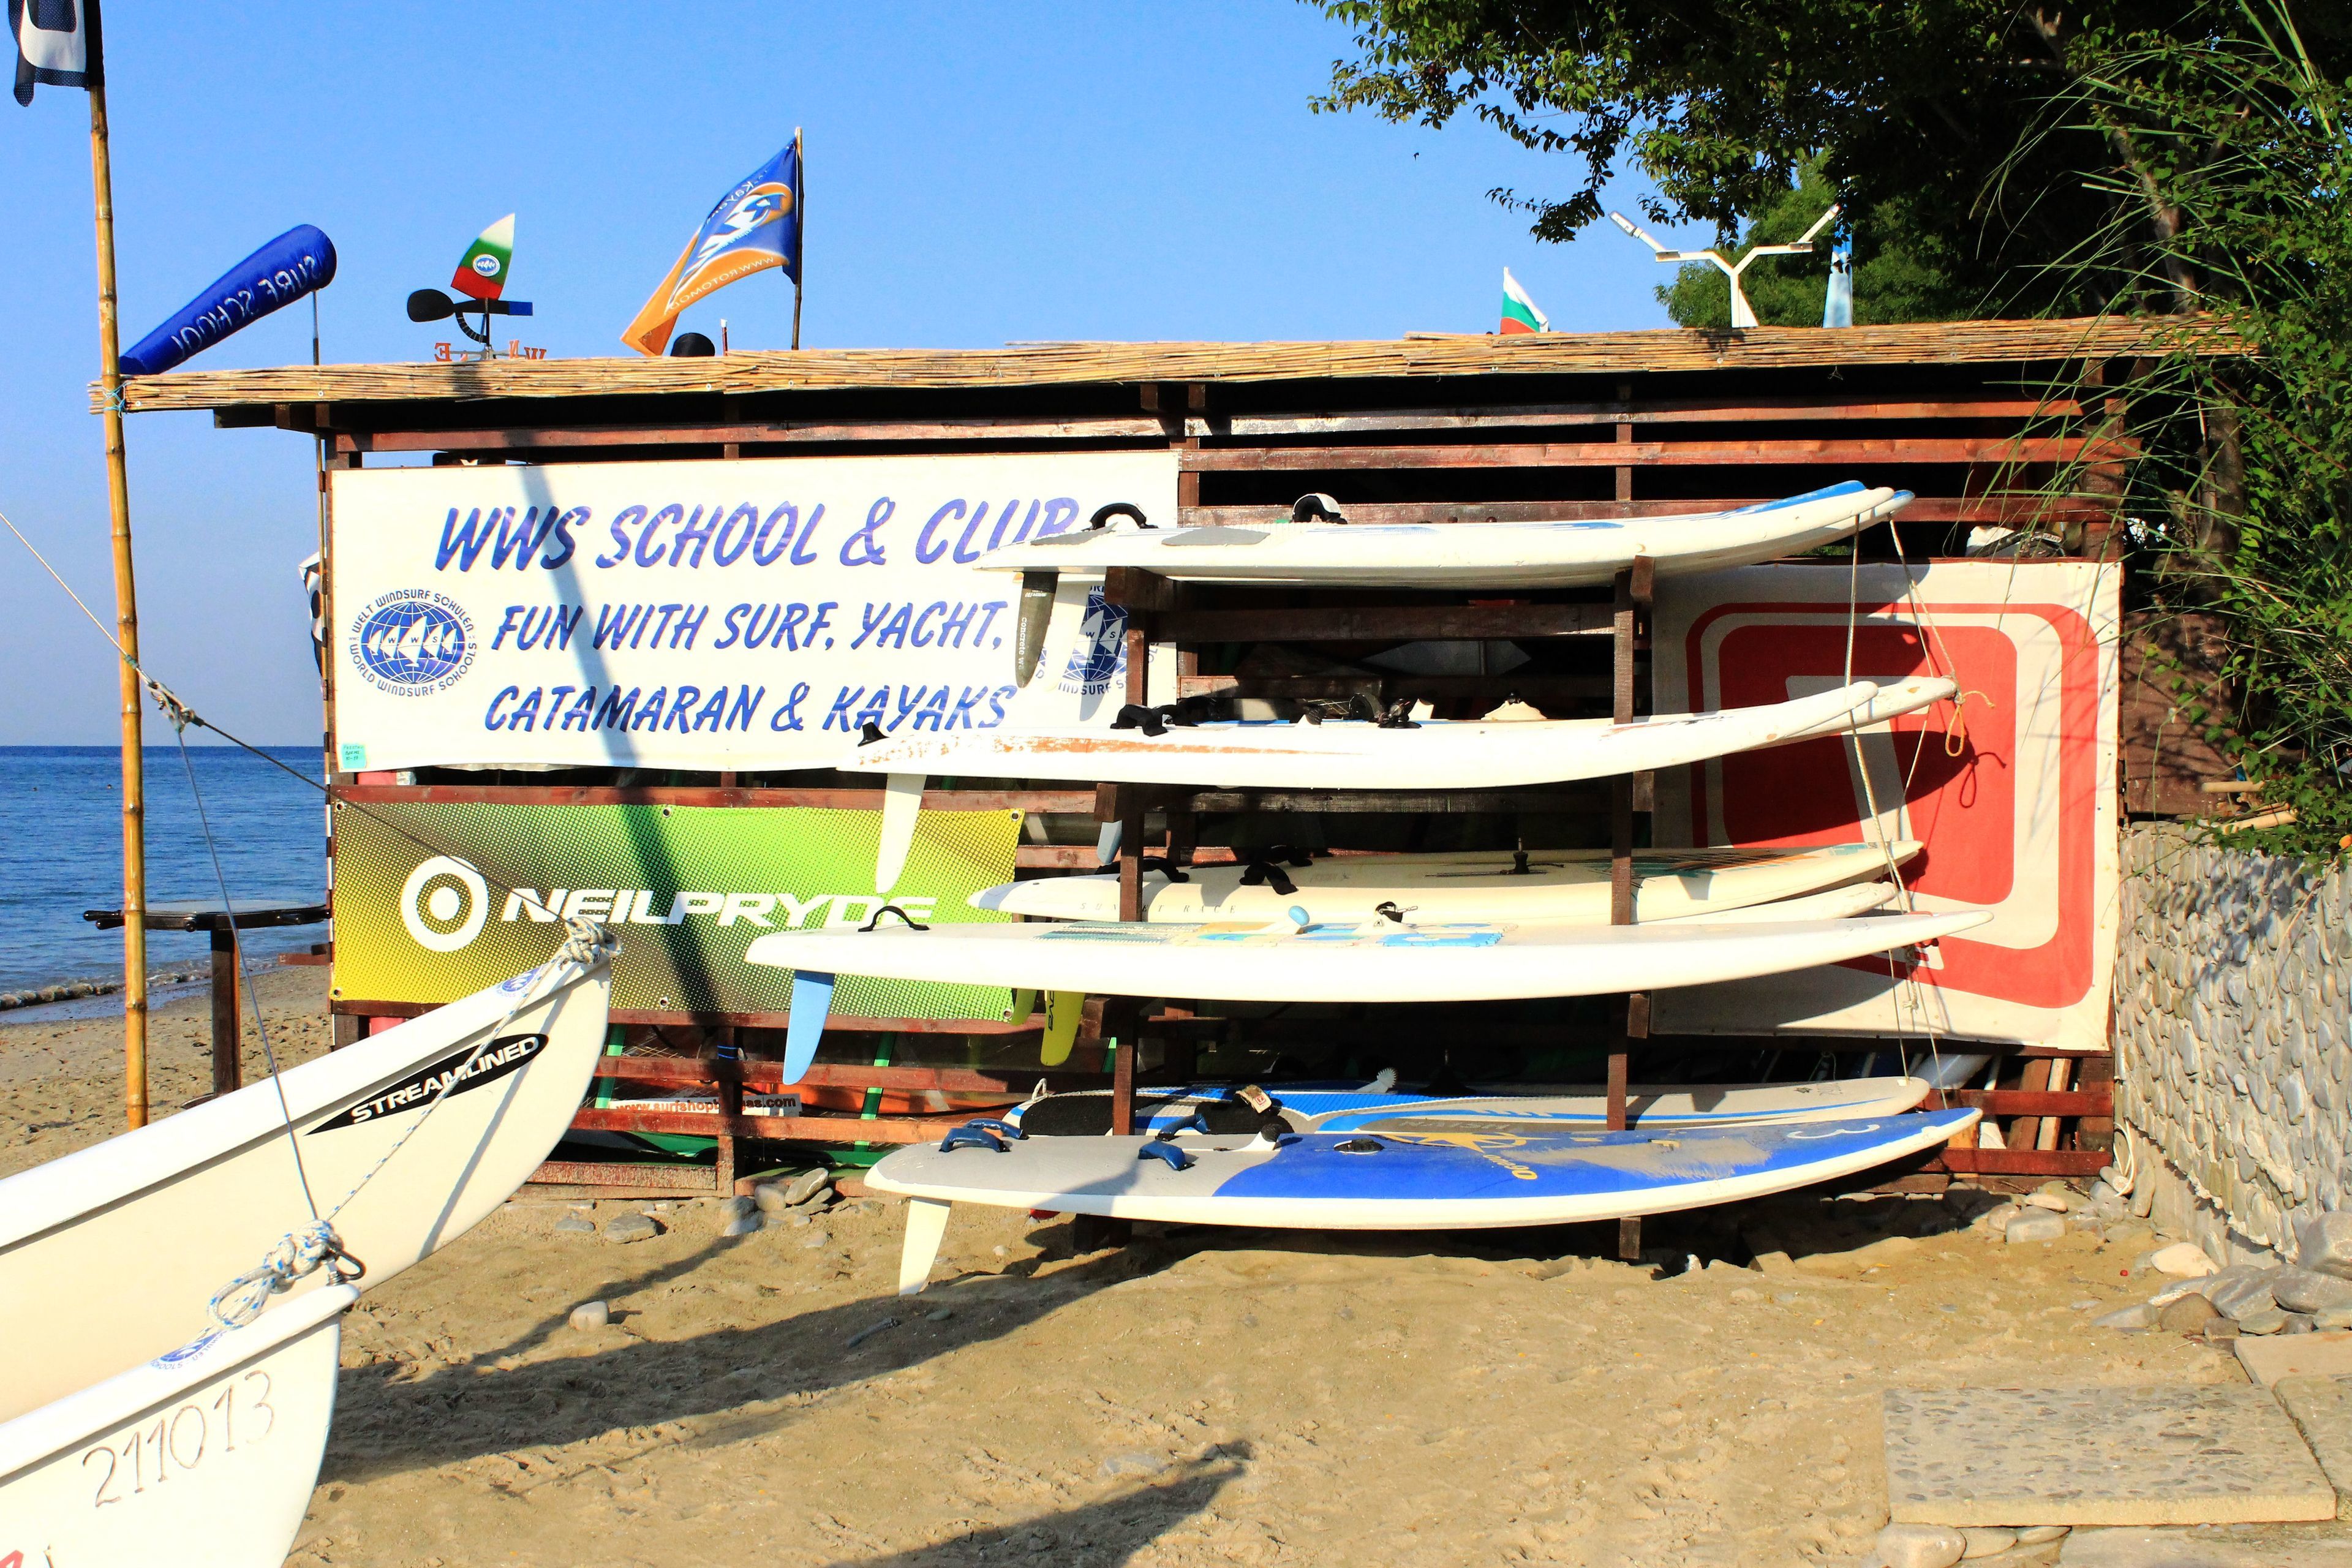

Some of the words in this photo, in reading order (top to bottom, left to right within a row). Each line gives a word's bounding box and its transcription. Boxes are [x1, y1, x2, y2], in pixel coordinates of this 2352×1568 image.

[435, 505, 592, 572] WWS
[595, 502, 824, 568] SCHOOL
[840, 497, 895, 566] &
[916, 497, 1080, 564] CLUB
[352, 605, 374, 633] WELT
[375, 589, 431, 608] WINDSURF
[434, 594, 475, 632] SCHULEN
[491, 604, 584, 650] FUN
[592, 603, 709, 650] WITH
[714, 601, 837, 650] SURF,
[850, 601, 1008, 650] YACHT,
[1019, 617, 1027, 655] concrete
[350, 644, 375, 683] WORLD
[377, 678, 435, 697] WINDSURF
[439, 643, 477, 691] SCHOOLS
[1058, 682, 1112, 695] INDSURF
[484, 684, 765, 734] CATAMARAN
[770, 682, 811, 732] &
[823, 685, 1018, 733] KAYAKS
[1079, 902, 1165, 913] SUNET
[1183, 904, 1237, 917] RACE
[350, 1036, 540, 1125] STREAMLINED
[82, 1371, 275, 1508] 211013
